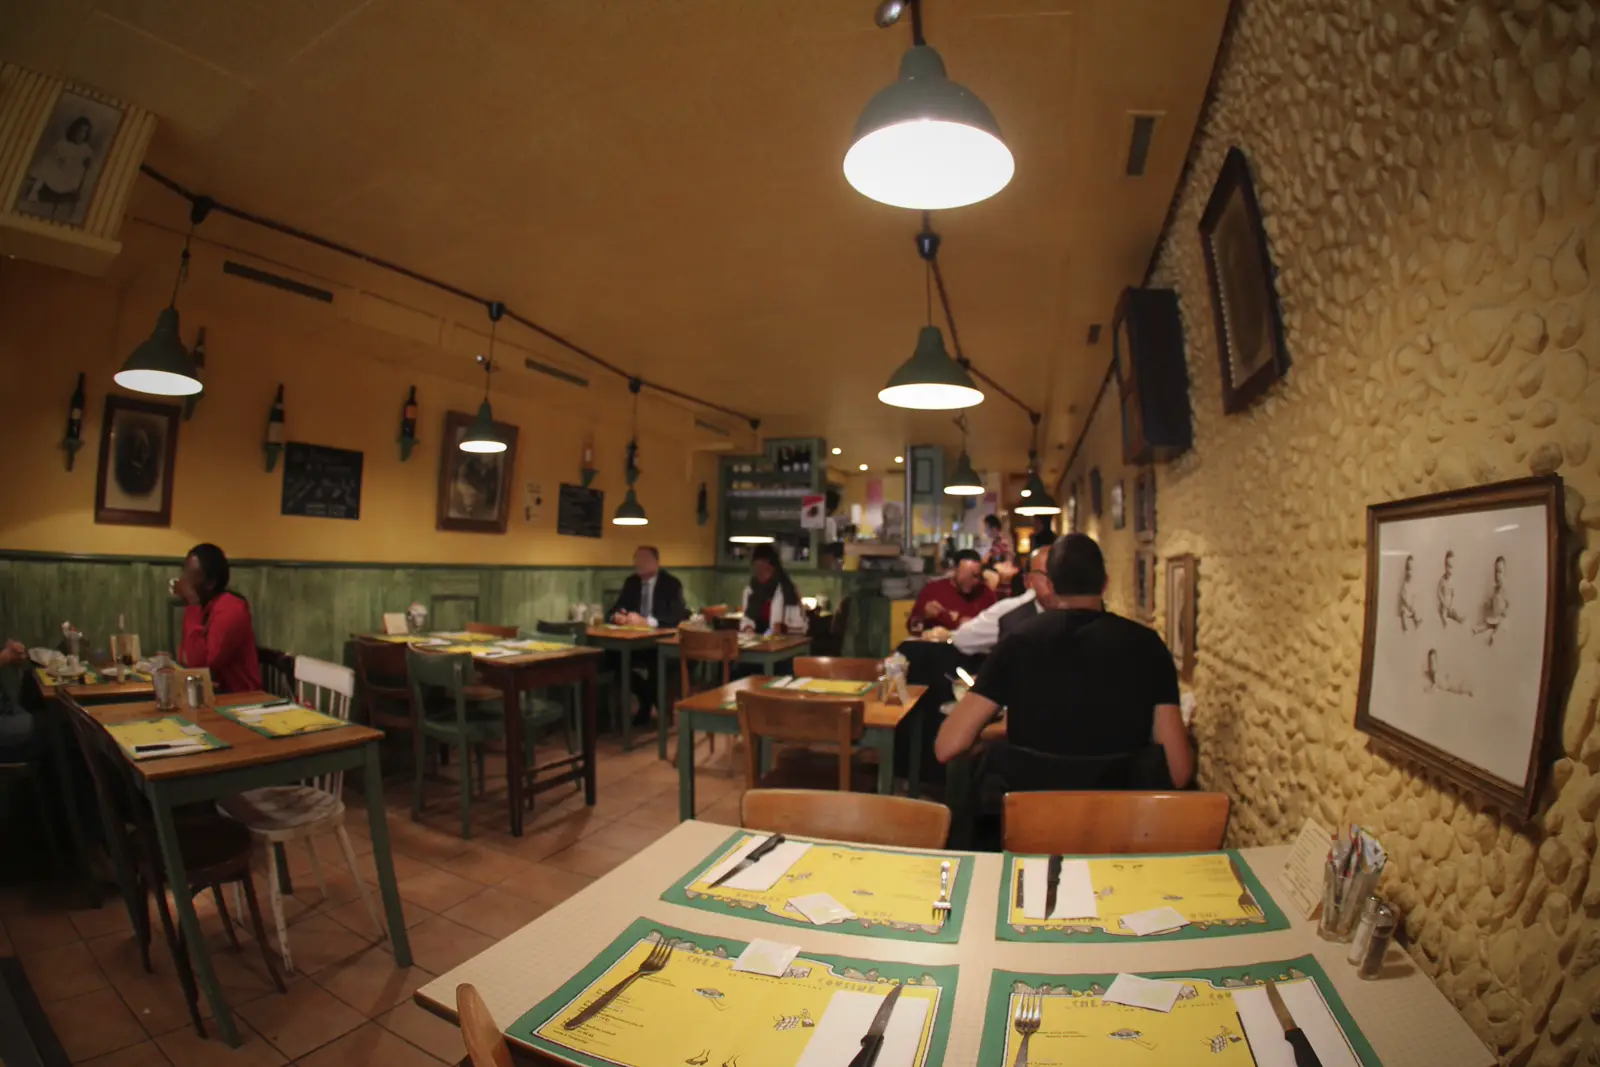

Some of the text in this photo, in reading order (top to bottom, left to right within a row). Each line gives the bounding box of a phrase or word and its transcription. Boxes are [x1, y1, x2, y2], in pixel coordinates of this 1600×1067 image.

[686, 954, 721, 969] CHEZ
[817, 976, 878, 993] COUSINE
[1208, 991, 1232, 1001] COU
